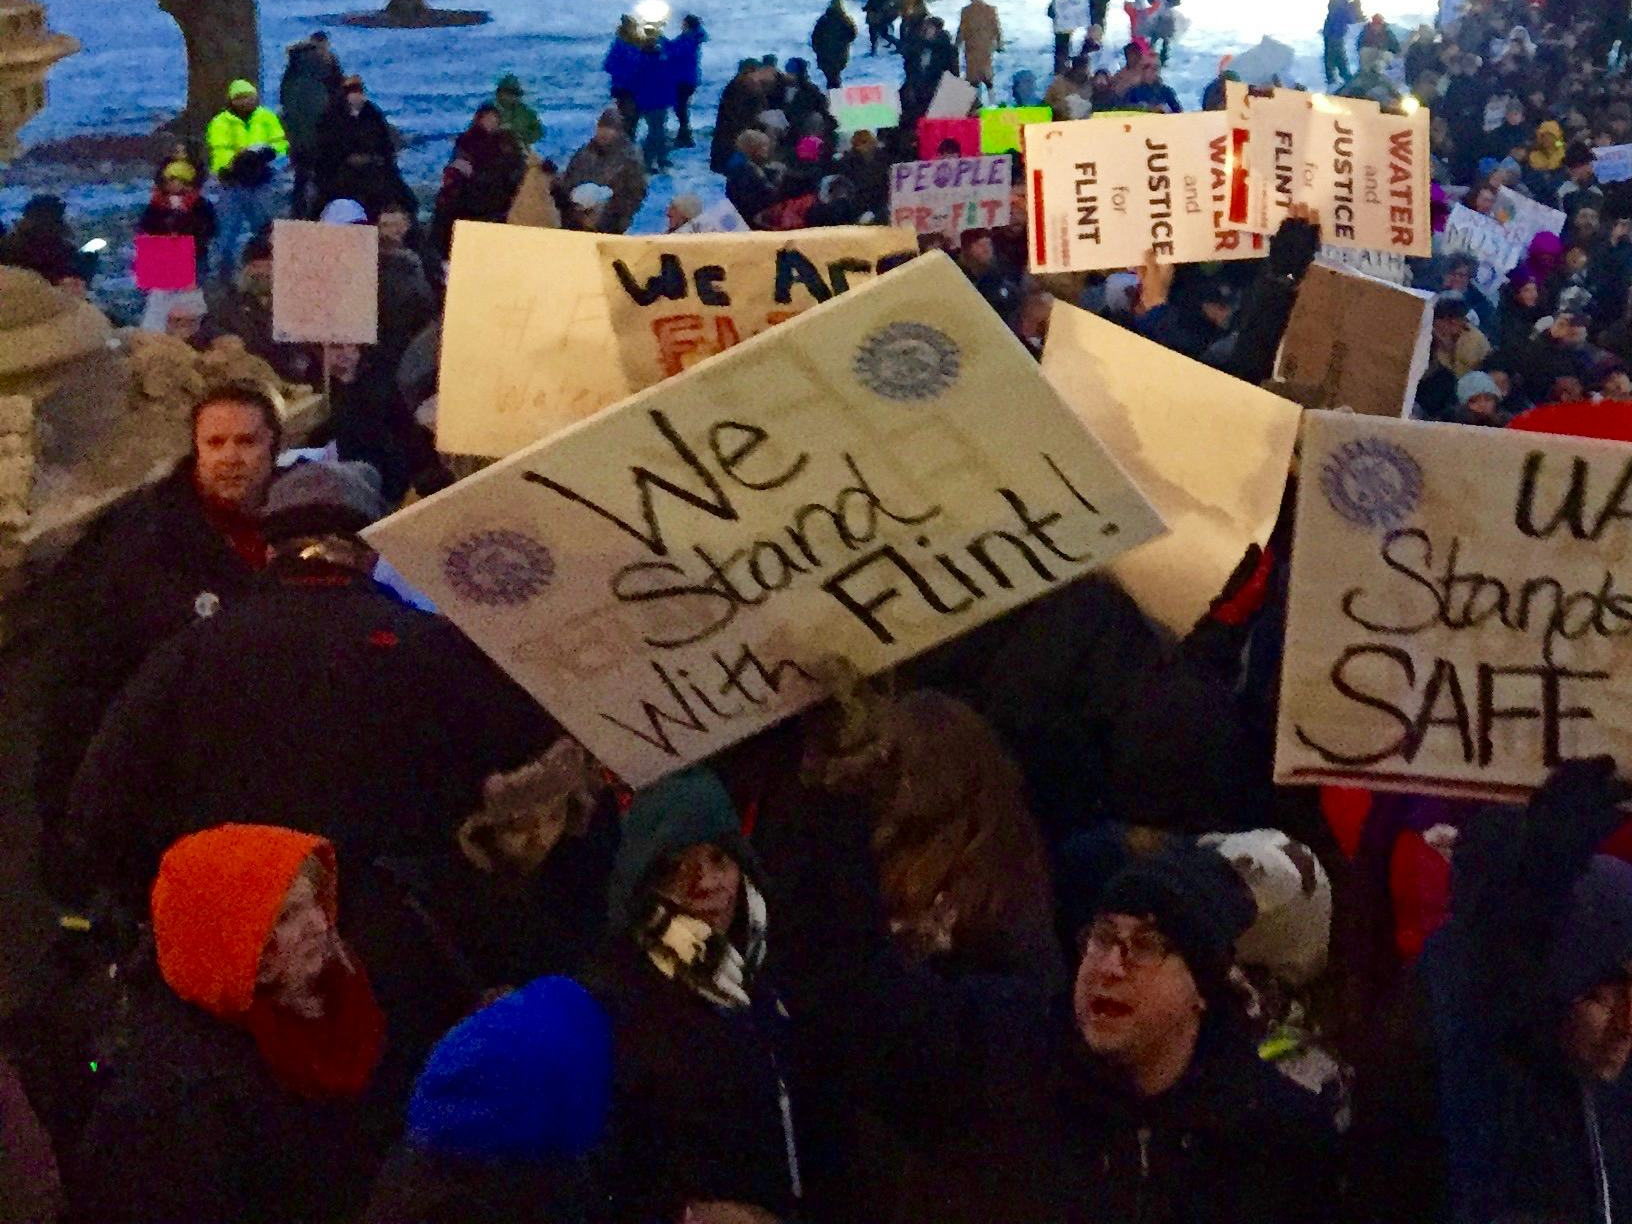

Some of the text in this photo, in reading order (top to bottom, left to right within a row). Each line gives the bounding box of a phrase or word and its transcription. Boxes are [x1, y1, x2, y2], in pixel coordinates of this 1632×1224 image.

[894, 158, 1007, 192] PEOPLE
[1074, 162, 1101, 245] FLINT
[1111, 184, 1127, 215] for
[1145, 137, 1175, 257] JUSTICE
[1183, 175, 1202, 215] and
[1275, 129, 1294, 207] FLINT
[1302, 162, 1319, 190] for
[1333, 120, 1355, 241] JUSTICE
[1363, 165, 1381, 204] and
[1388, 128, 1414, 247] WATER
[522, 409, 811, 555] We
[612, 452, 940, 648] Stand
[822, 452, 1121, 645] Flint!
[1295, 642, 1609, 769] SAFE
